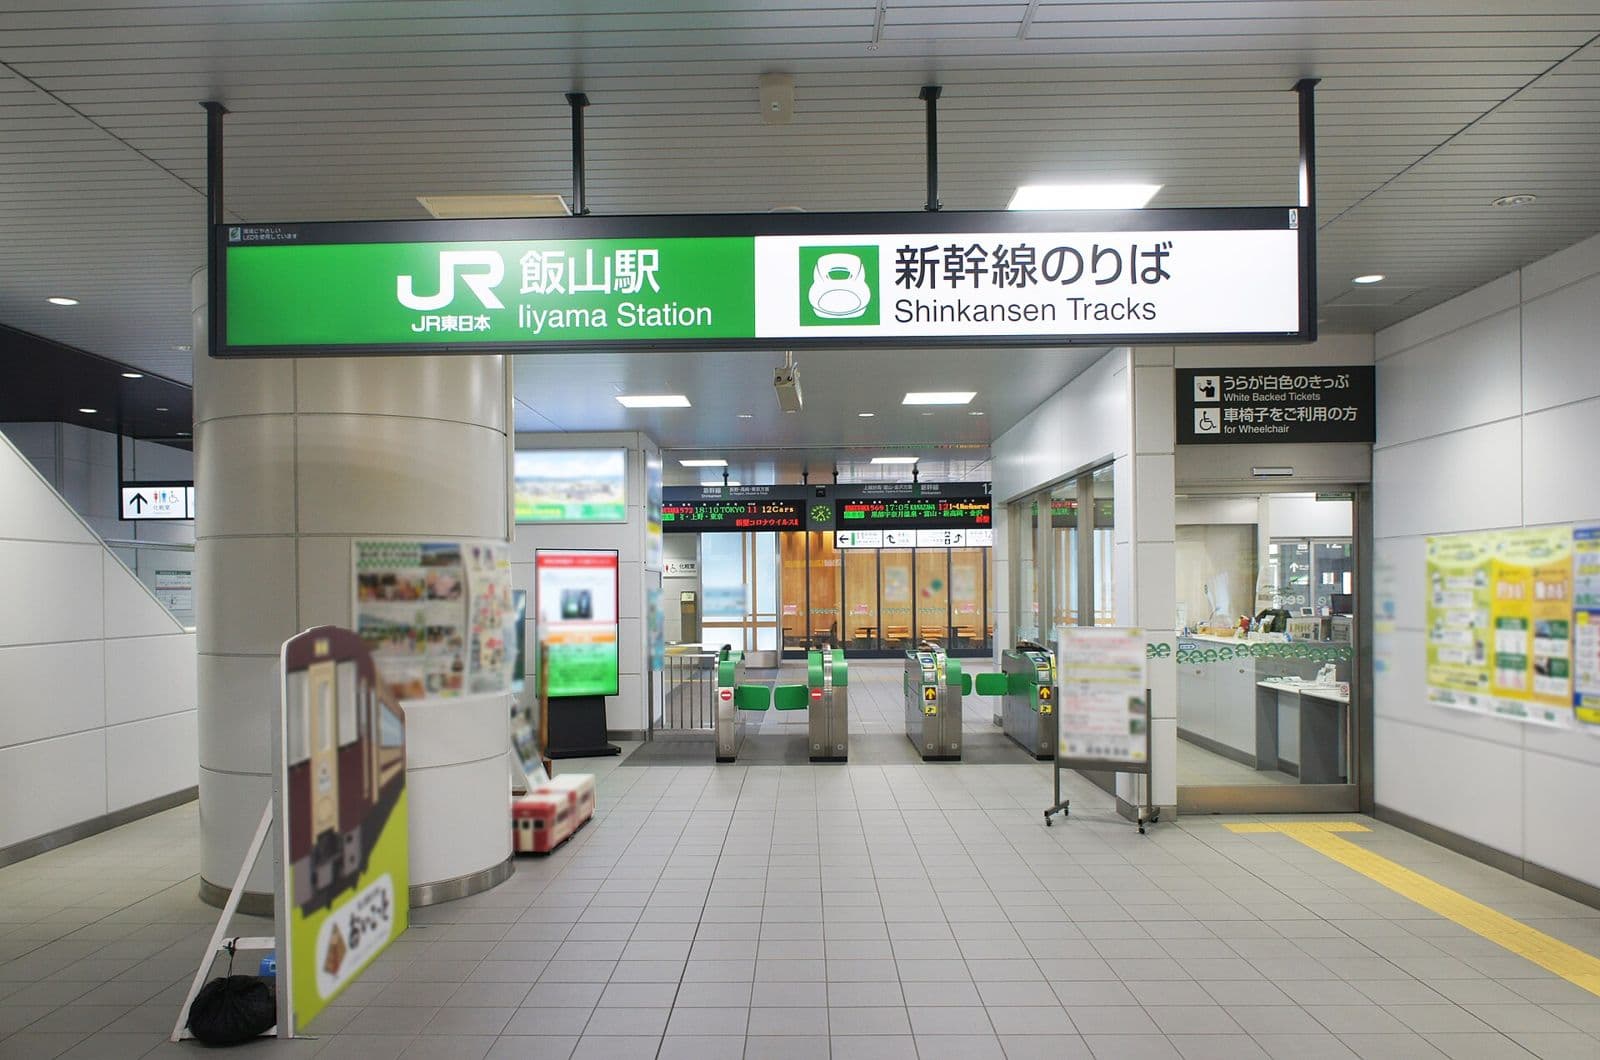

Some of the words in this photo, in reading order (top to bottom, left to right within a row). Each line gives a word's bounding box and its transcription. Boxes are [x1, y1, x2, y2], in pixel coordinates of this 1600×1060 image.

[518, 248, 661, 296] 飯山駅
[894, 240, 1173, 290] 新幹線のりば
[396, 250, 505, 310] JR
[518, 303, 607, 332] Iiyama
[616, 301, 713, 328] Station
[894, 298, 1057, 324] Shinkansen
[1066, 297, 1157, 321] Tracks
[411, 314, 491, 333] JR東日本
[1223, 374, 1350, 391] うらが白色のきっぷ
[1224, 392, 1250, 401] White
[1252, 392, 1286, 401] Backed
[1288, 391, 1321, 401] Tickets
[1223, 406, 1359, 423] 車椅子をご利用の方
[1223, 425, 1237, 434] for
[1239, 424, 1290, 434] Wheelchair
[695, 506, 719, 514] 18:10
[747, 505, 758, 514] 11
